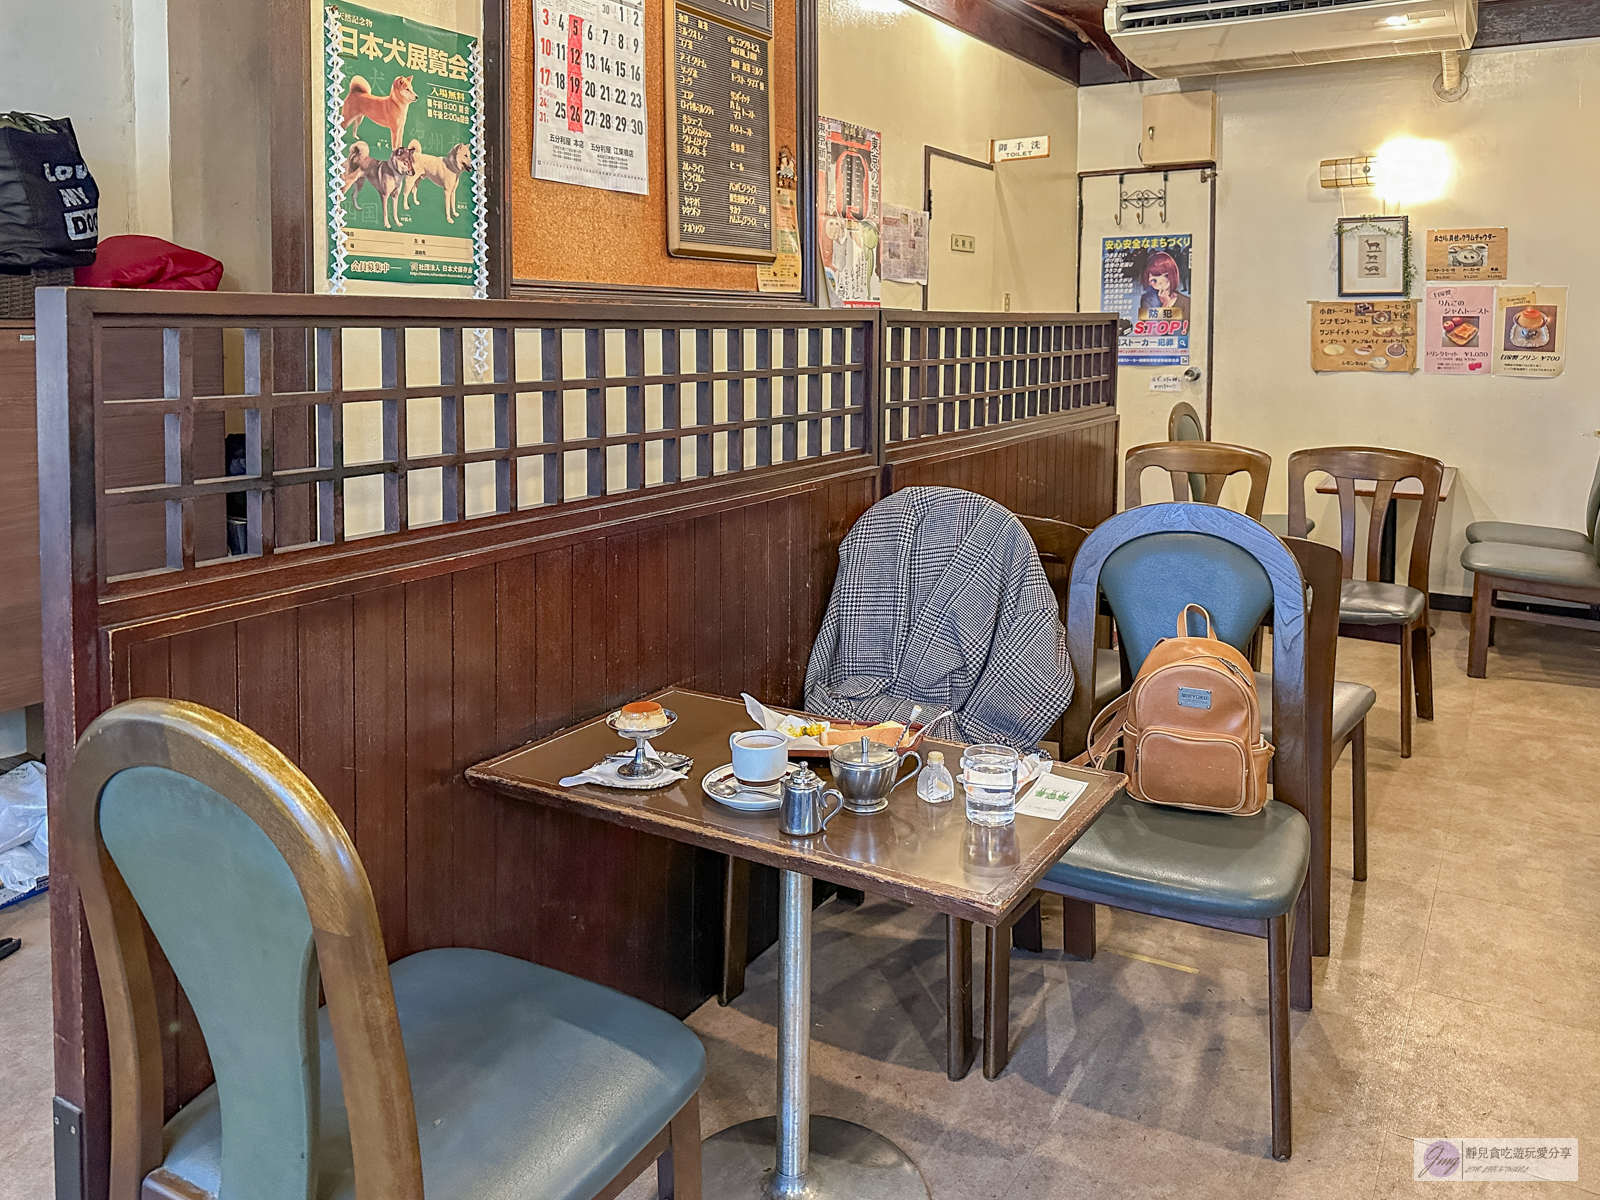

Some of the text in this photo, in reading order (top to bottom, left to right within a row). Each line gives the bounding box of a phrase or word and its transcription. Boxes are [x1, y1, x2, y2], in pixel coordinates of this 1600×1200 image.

[602, 4, 610, 14] 30
[619, 7, 624, 22] 1
[633, 11, 639, 27] 2
[542, 8, 549, 25] 3
[558, 14, 564, 31] 4
[573, 19, 578, 36] 5
[587, 25, 593, 41] 6
[602, 29, 609, 45] 7
[618, 33, 624, 49] 8
[633, 38, 639, 53] 9
[337, 25, 469, 82] 日本犬展覧会
[540, 37, 640, 82] 10 11 12 13 14 15 16
[430, 87, 465, 101] 入場無料
[540, 67, 550, 86] 17
[555, 71, 565, 90] 18
[570, 76, 580, 94] 19
[585, 80, 596, 98] 20
[600, 84, 610, 102] 21
[615, 88, 626, 105] 22
[630, 91, 641, 109] 23
[539, 96, 547, 107] 24
[539, 111, 547, 122] 31
[555, 101, 643, 135] 25 26 27 28 29 30
[573, 139, 584, 149] 本店
[998, 140, 1041, 152] 御手洗
[1005, 150, 1033, 158] TOILET
[682, 161, 705, 174] カレーライス
[682, 171, 706, 183] ドライカレー
[683, 181, 700, 192] ピラフ
[58, 186, 90, 208] MY
[1104, 237, 1191, 250] 安心安全なまちづくり
[1148, 309, 1173, 319] 防犯
[1133, 320, 1189, 336] STOP!
